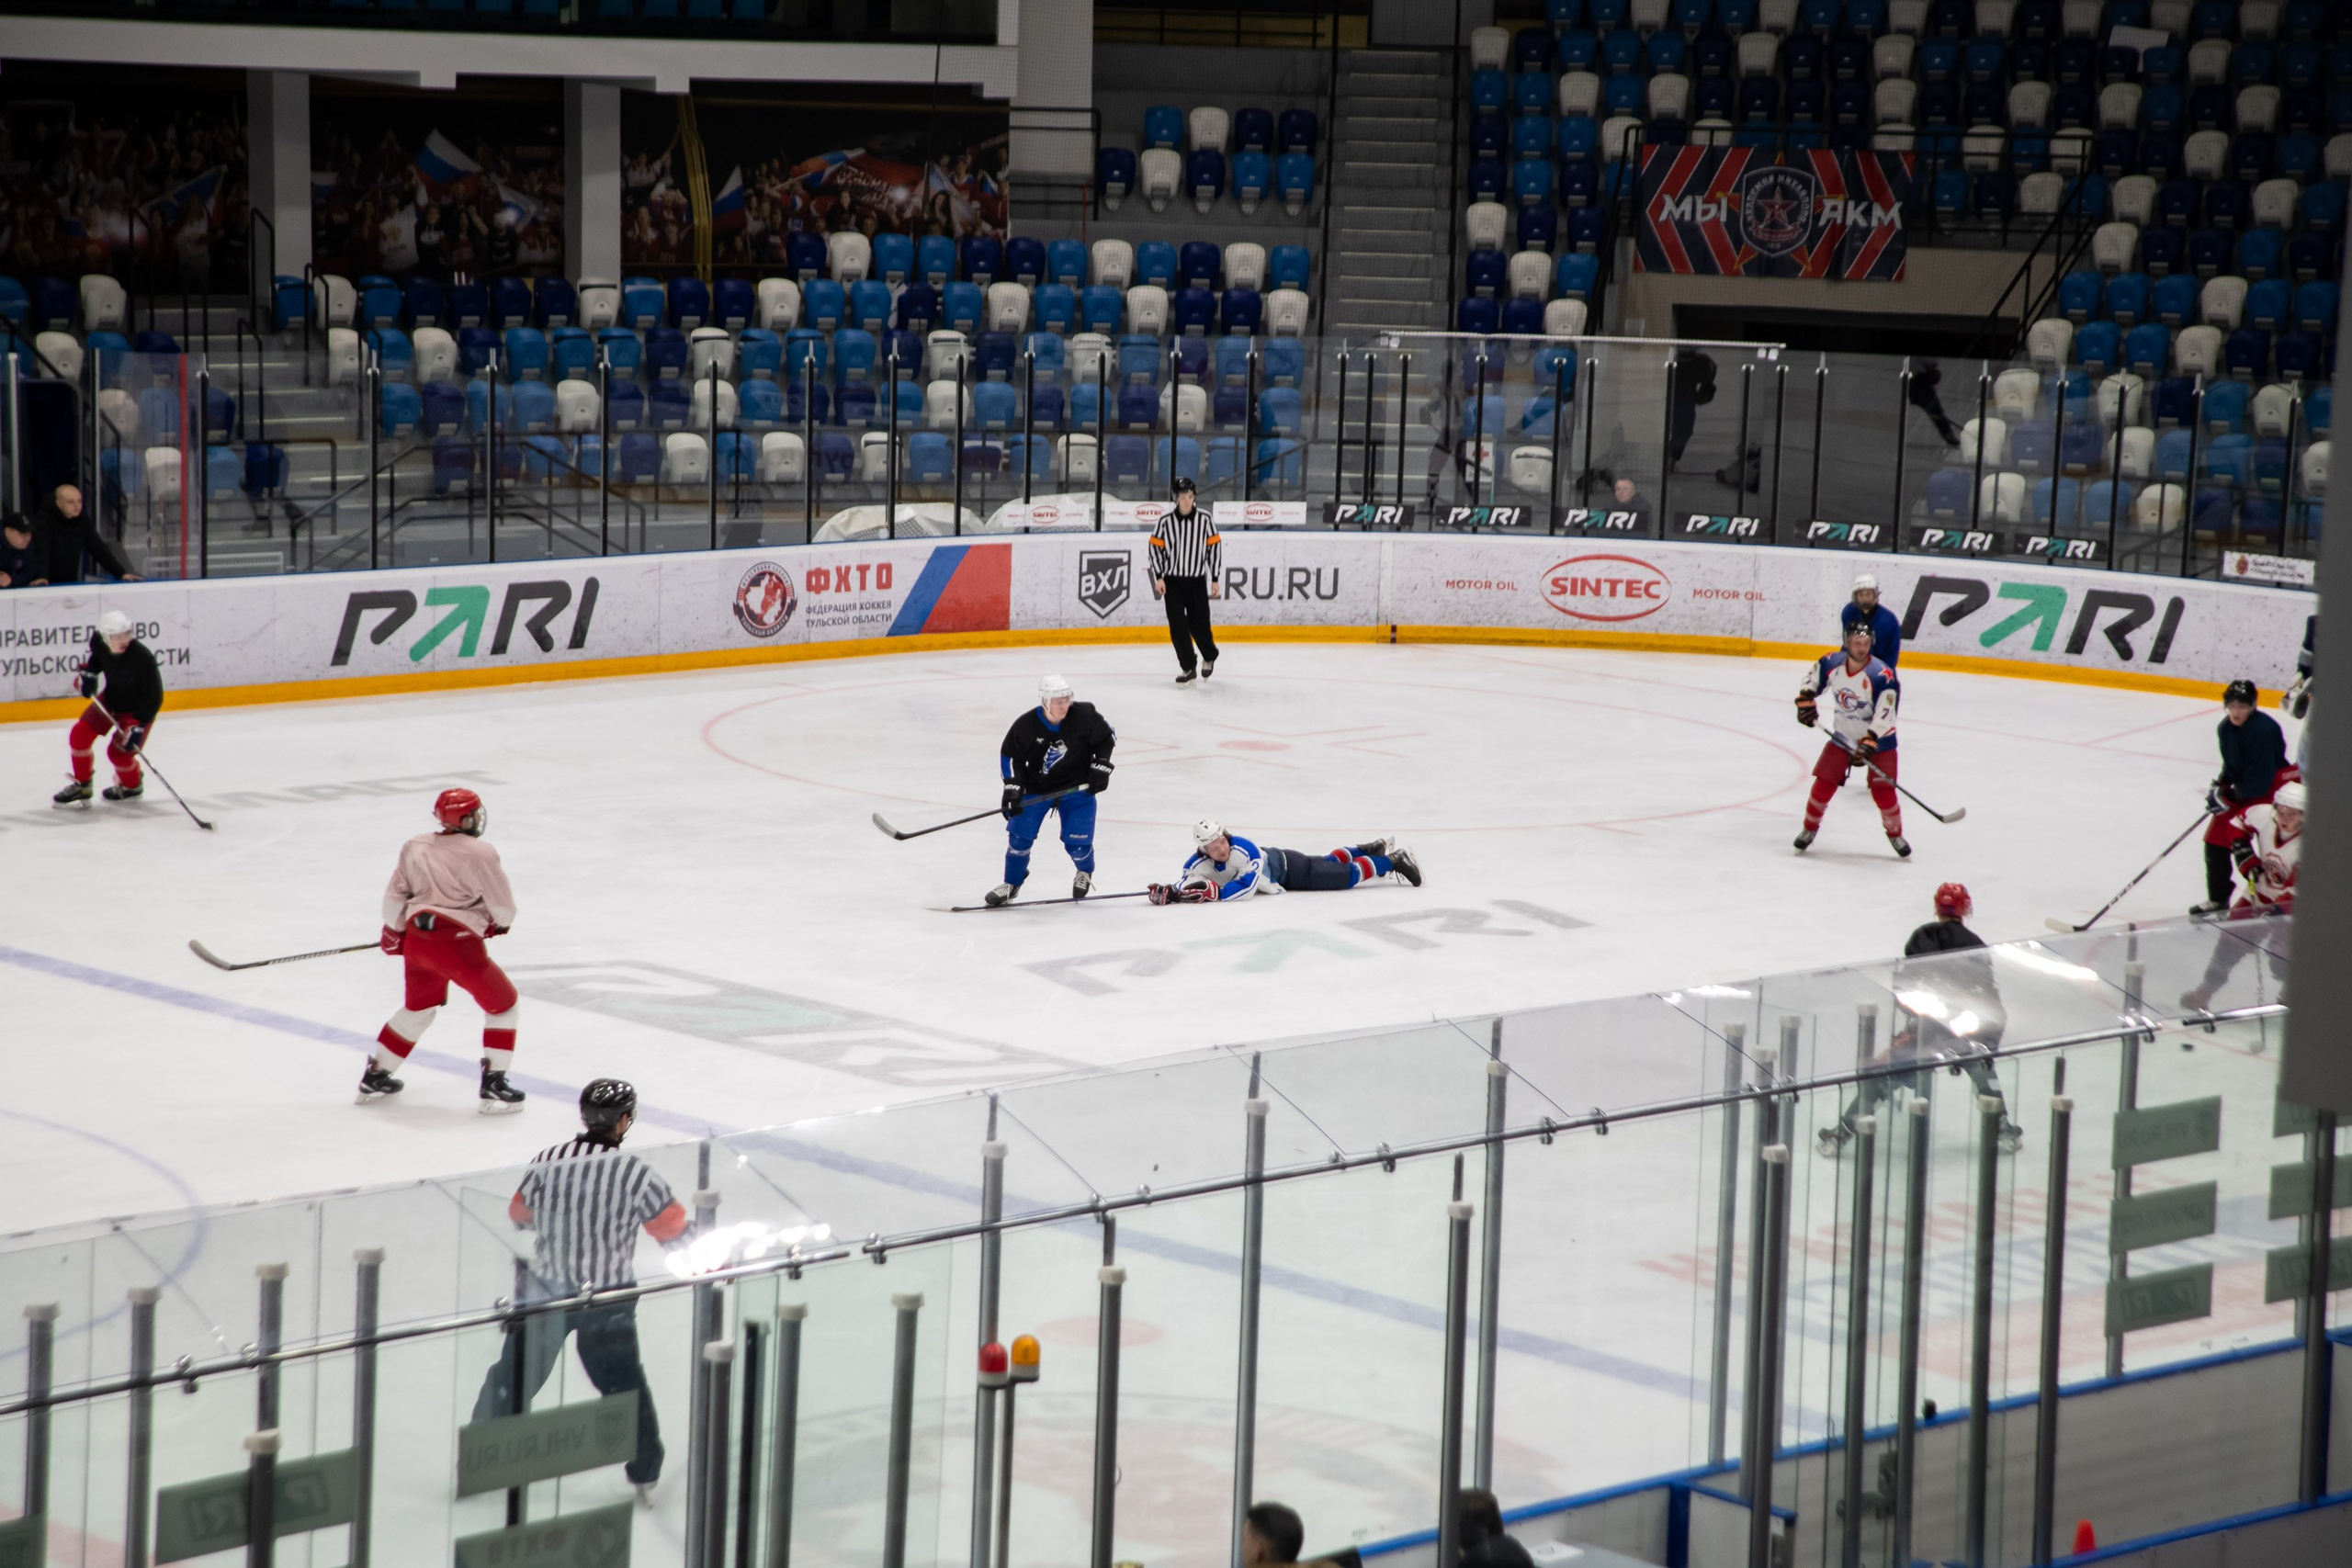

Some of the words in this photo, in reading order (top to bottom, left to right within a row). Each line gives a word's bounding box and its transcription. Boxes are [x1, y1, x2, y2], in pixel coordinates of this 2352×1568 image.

[1657, 194, 1728, 223] МЫ
[1818, 197, 1904, 230] АКМ
[1334, 504, 1404, 525] PARI
[1448, 506, 1521, 526] PARI
[1565, 507, 1637, 531] PARI
[1686, 513, 1760, 536] PARI
[1806, 522, 1880, 544] PARI
[1921, 528, 1994, 551] PARI
[2025, 536, 2096, 559] PARI
[806, 562, 892, 594] ФХТО
[1080, 565, 1128, 597] ВХЛ
[1445, 579, 1494, 591] MOTOR
[1496, 581, 1518, 592] OIL
[1550, 576, 1661, 600] SINTEC
[1693, 588, 1740, 601] MOTOR
[1744, 591, 1767, 602] OIL
[806, 602, 857, 615] ФЕДЕРАЦИЯ
[859, 600, 892, 611] ХОККЕЯ
[1902, 574, 2186, 664] PARI
[331, 576, 600, 667] PARI
[806, 615, 850, 628] ТУЛЬСКОЙ
[852, 613, 892, 626] ОБЛАСТИ
[1016, 898, 1590, 997] PARI
